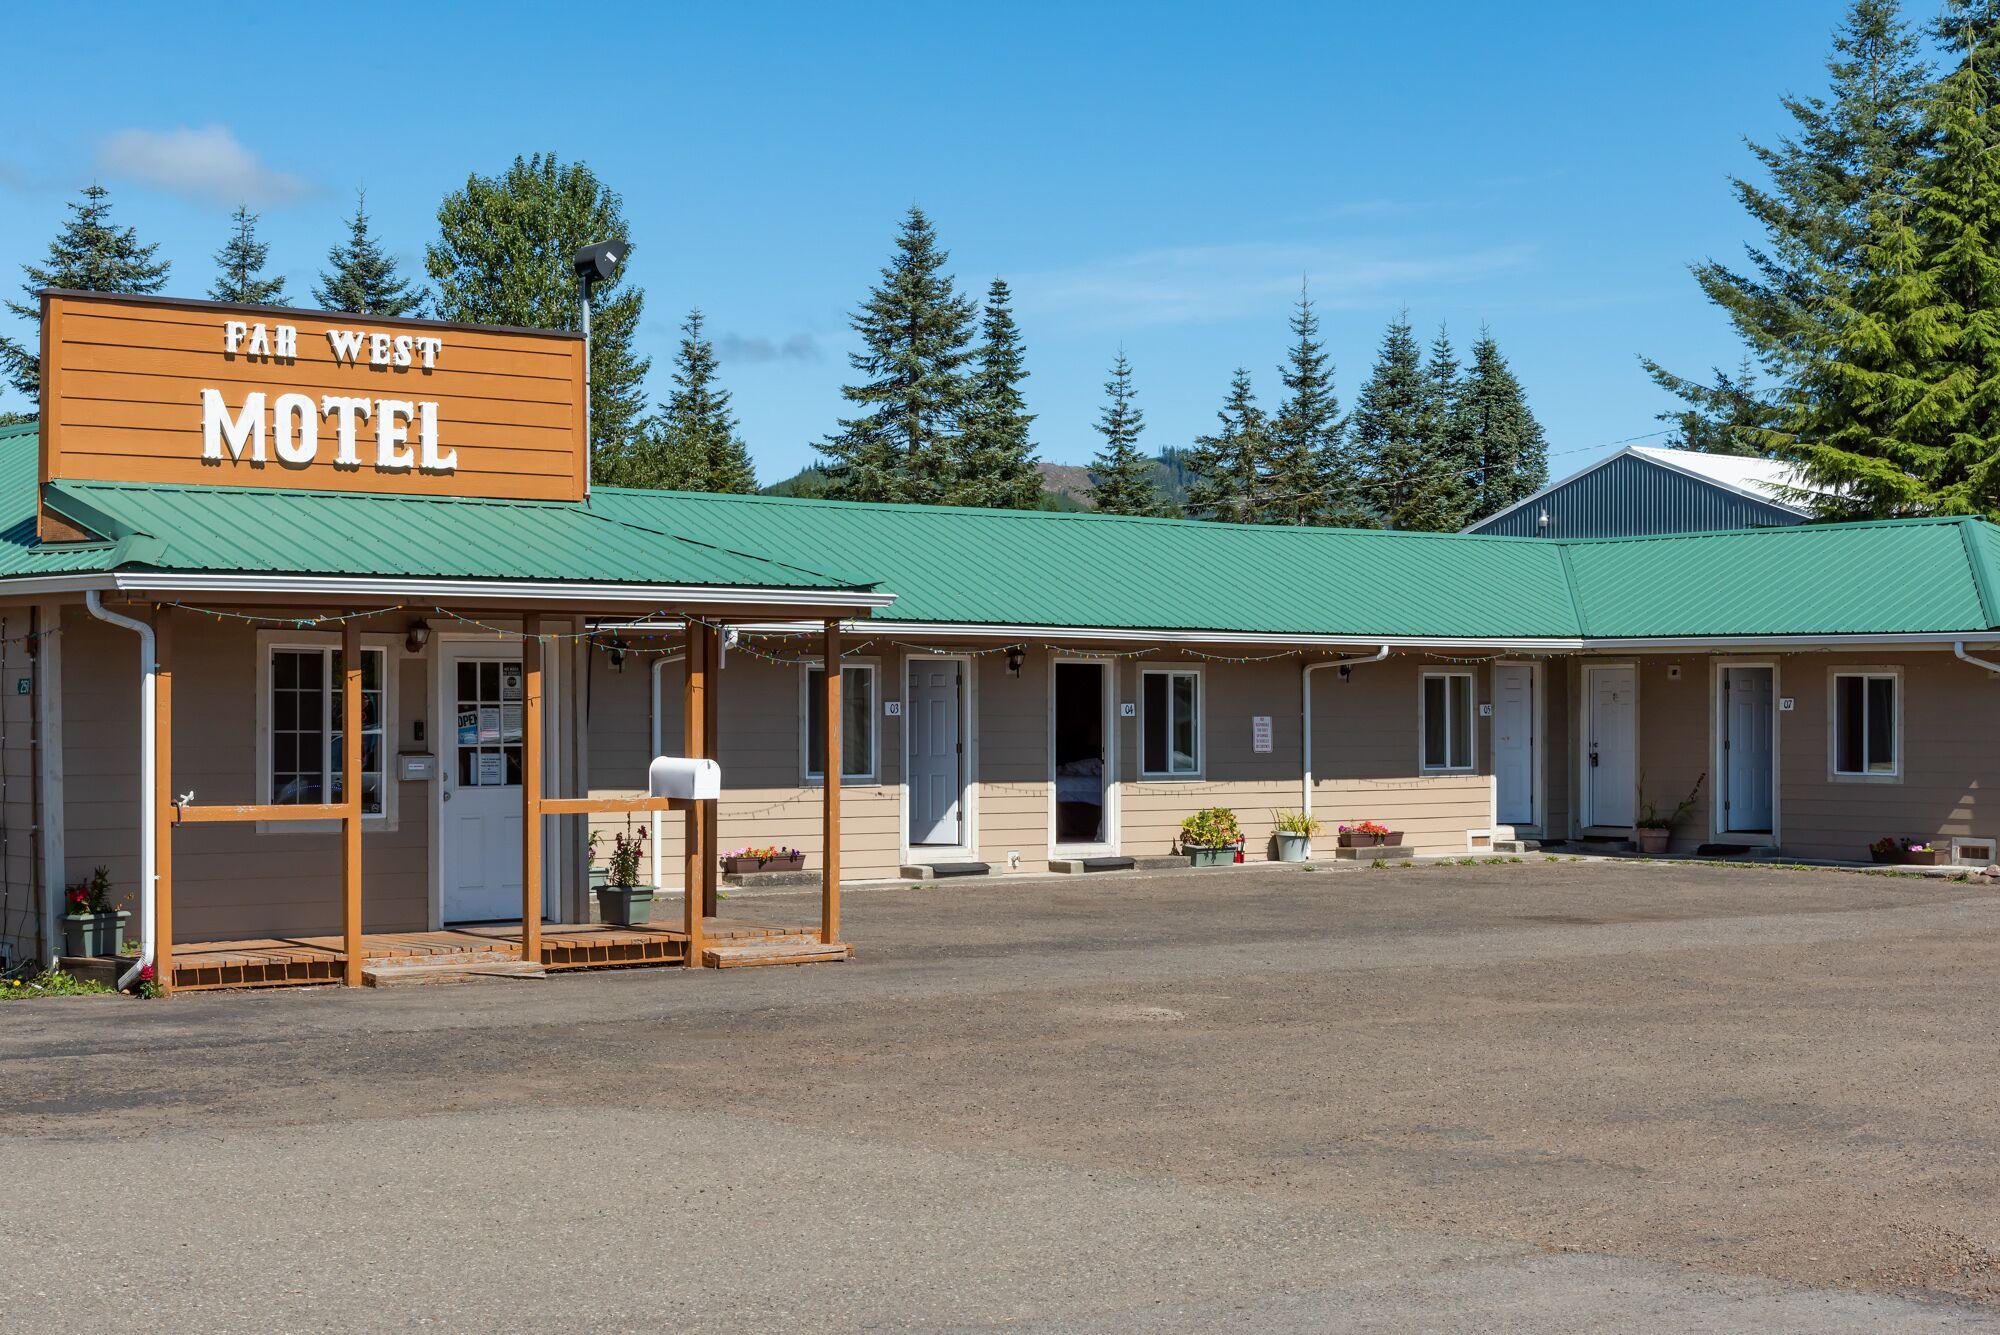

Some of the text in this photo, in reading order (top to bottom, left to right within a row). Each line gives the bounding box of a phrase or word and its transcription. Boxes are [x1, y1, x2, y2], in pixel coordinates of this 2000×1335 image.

[224, 320, 442, 368] FAR WEST
[201, 388, 458, 470] MOTEL
[890, 703, 899, 714] 03
[1125, 704, 1133, 715] 04
[1783, 699, 1792, 709] 07
